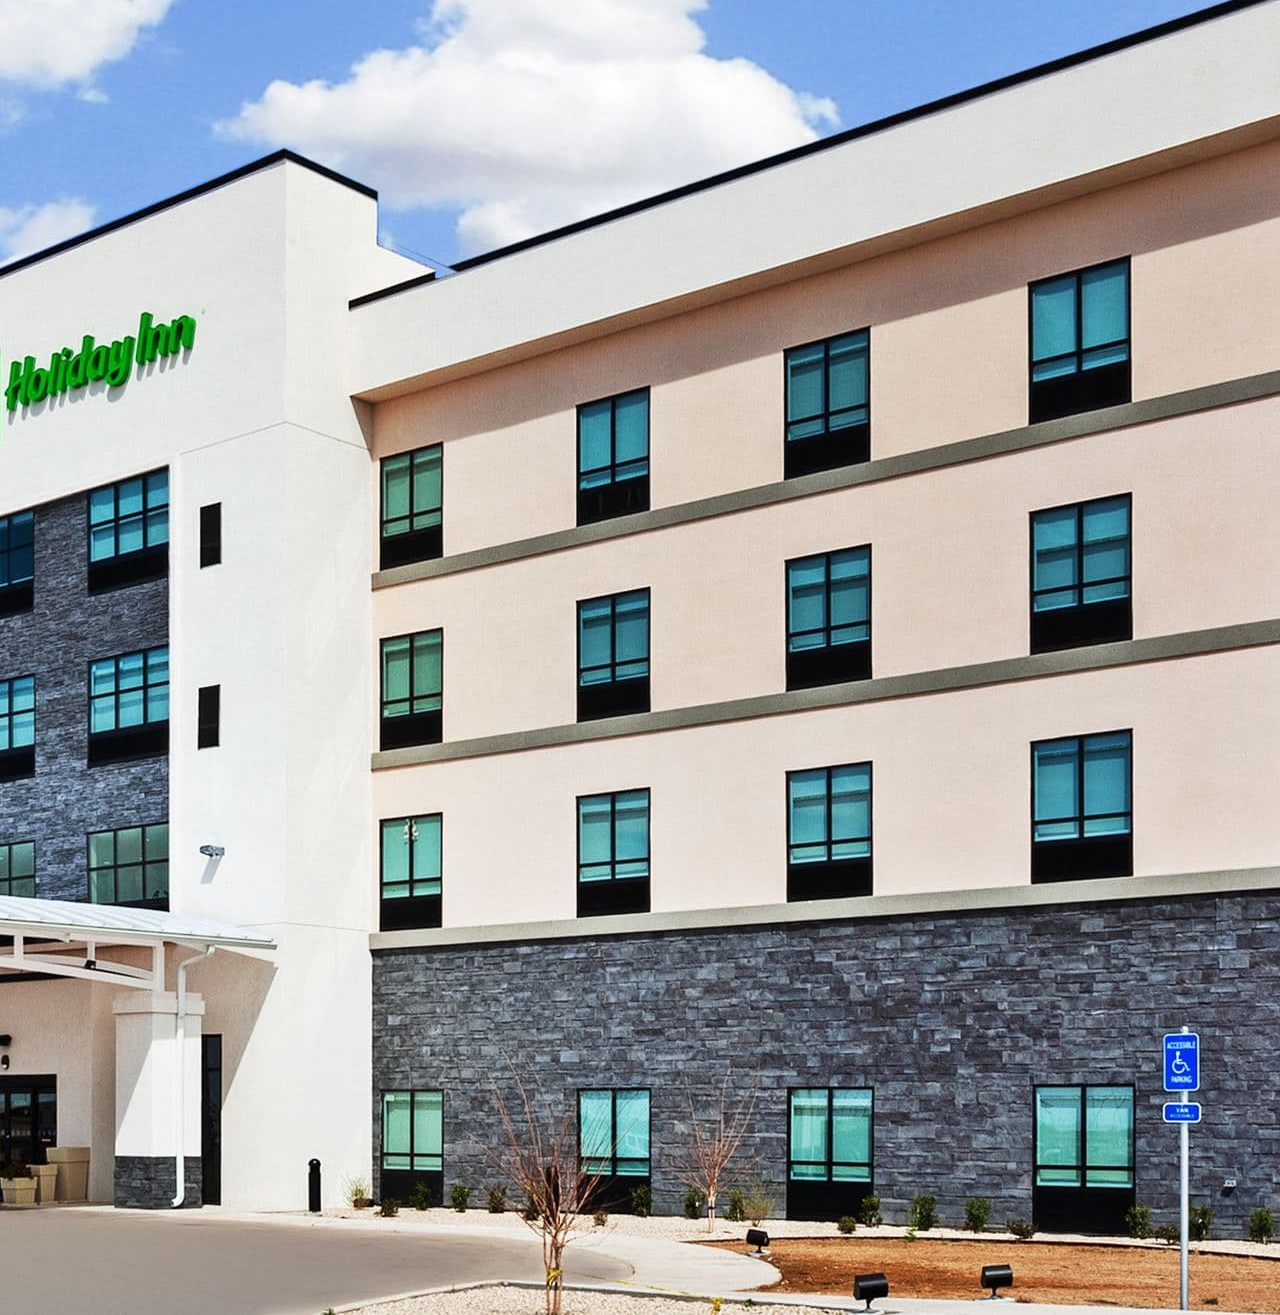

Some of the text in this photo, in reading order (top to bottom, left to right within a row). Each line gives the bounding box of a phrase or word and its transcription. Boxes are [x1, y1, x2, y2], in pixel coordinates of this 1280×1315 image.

[5, 311, 197, 412] Holiday Inn
[1166, 1040, 1196, 1049] ACCESSIBLE
[1170, 1075, 1192, 1084] PARKING
